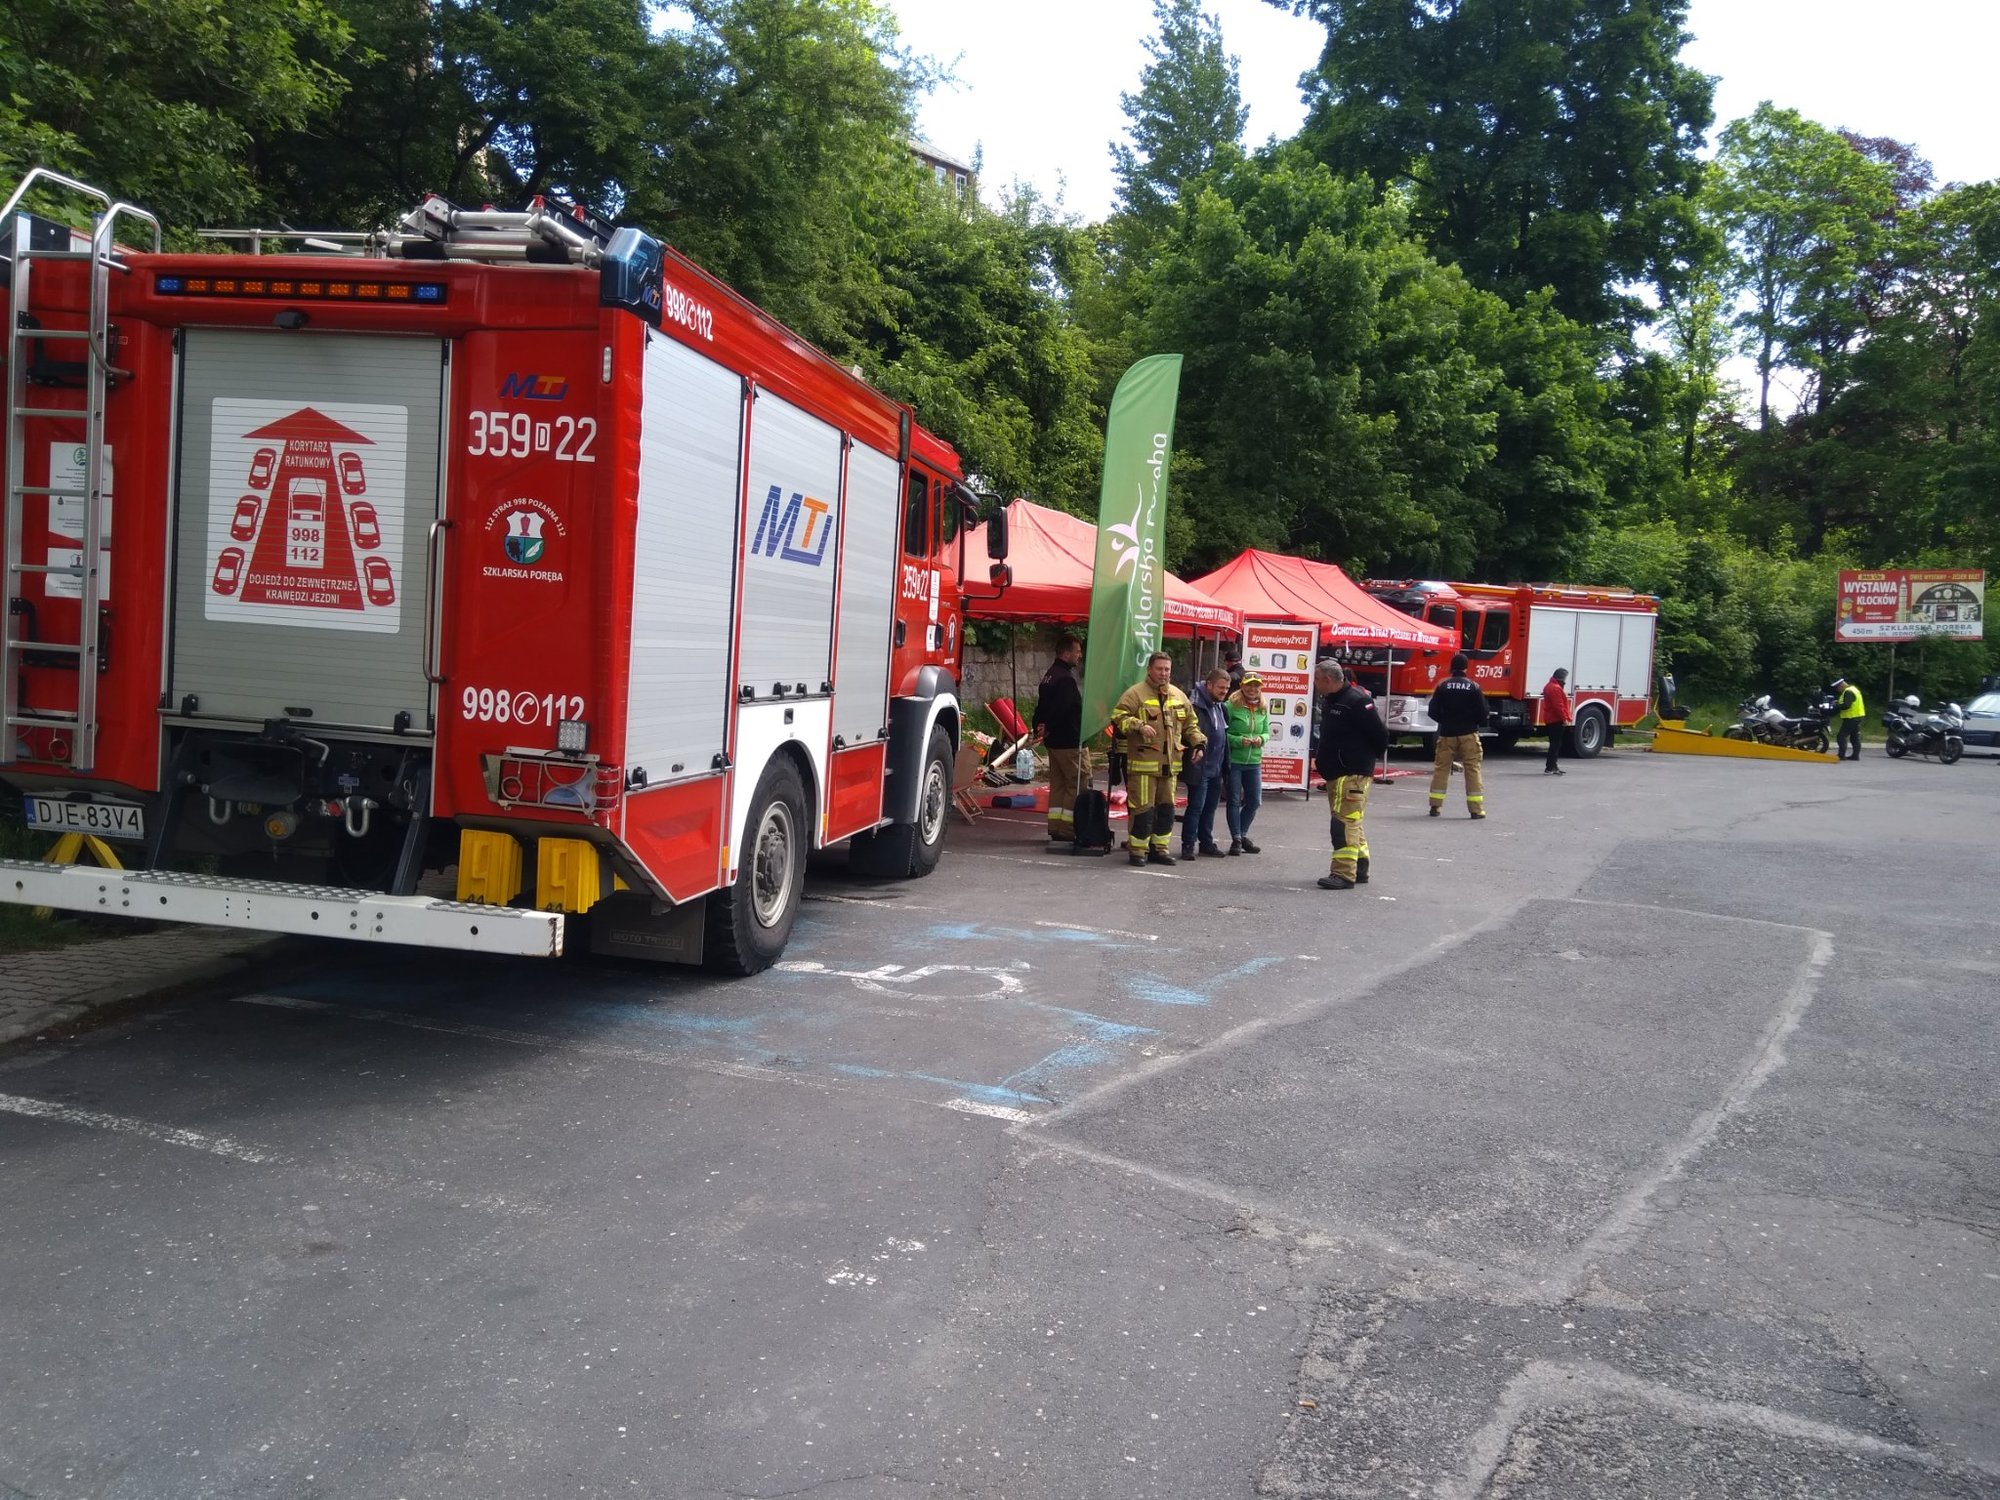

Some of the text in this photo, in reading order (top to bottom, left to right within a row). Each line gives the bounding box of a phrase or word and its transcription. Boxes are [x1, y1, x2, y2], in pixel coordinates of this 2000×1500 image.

[666, 284, 714, 342] 998 112
[289, 440, 328, 453] KORYTARZ
[285, 455, 331, 469] RATUNKOWY
[484, 517, 495, 531] 112
[512, 497, 527, 506] 998
[556, 522, 567, 537] 112
[291, 528, 320, 542] 998
[291, 547, 320, 561] 112
[483, 566, 564, 583] SZKLARSKA PORĘBA
[283, 576, 295, 587] DO
[296, 576, 358, 592] ZEWNĘTRZNEJ
[1844, 581, 1898, 593] WYSTAWA
[266, 589, 340, 604] KRAWĘDZI JEZDNI
[1136, 538, 1158, 667] Szklarska
[1856, 593, 1897, 605] KLOCKÓW
[1331, 623, 1369, 636] OCHOTNICZA
[1251, 634, 1308, 646] #promujemyŻYCIE
[462, 686, 585, 726] 998 112
[38, 801, 80, 826] DJE
[86, 806, 139, 832] 83V4
